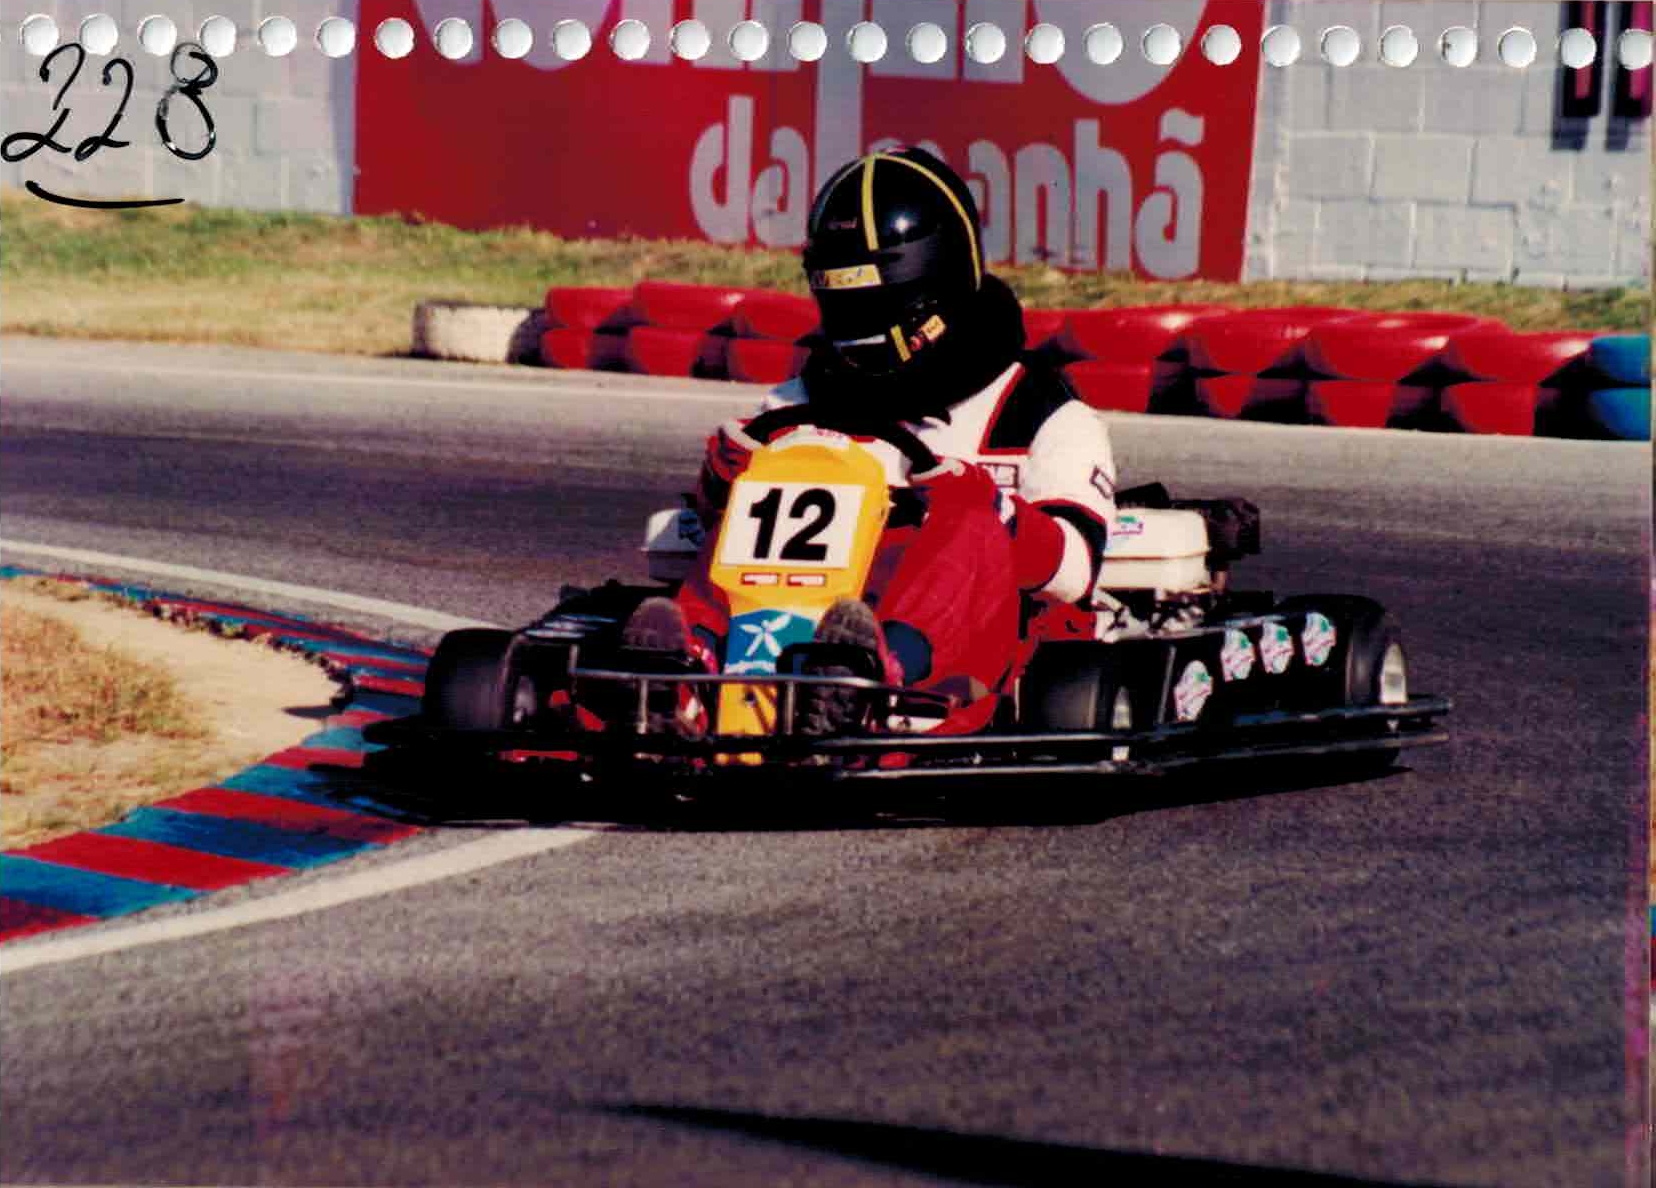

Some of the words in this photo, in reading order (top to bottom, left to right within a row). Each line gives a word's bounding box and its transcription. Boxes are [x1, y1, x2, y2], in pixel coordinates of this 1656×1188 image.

[0, 42, 218, 161] 228
[689, 94, 808, 248] da
[868, 107, 1204, 280] anhã
[748, 487, 837, 562] 12
